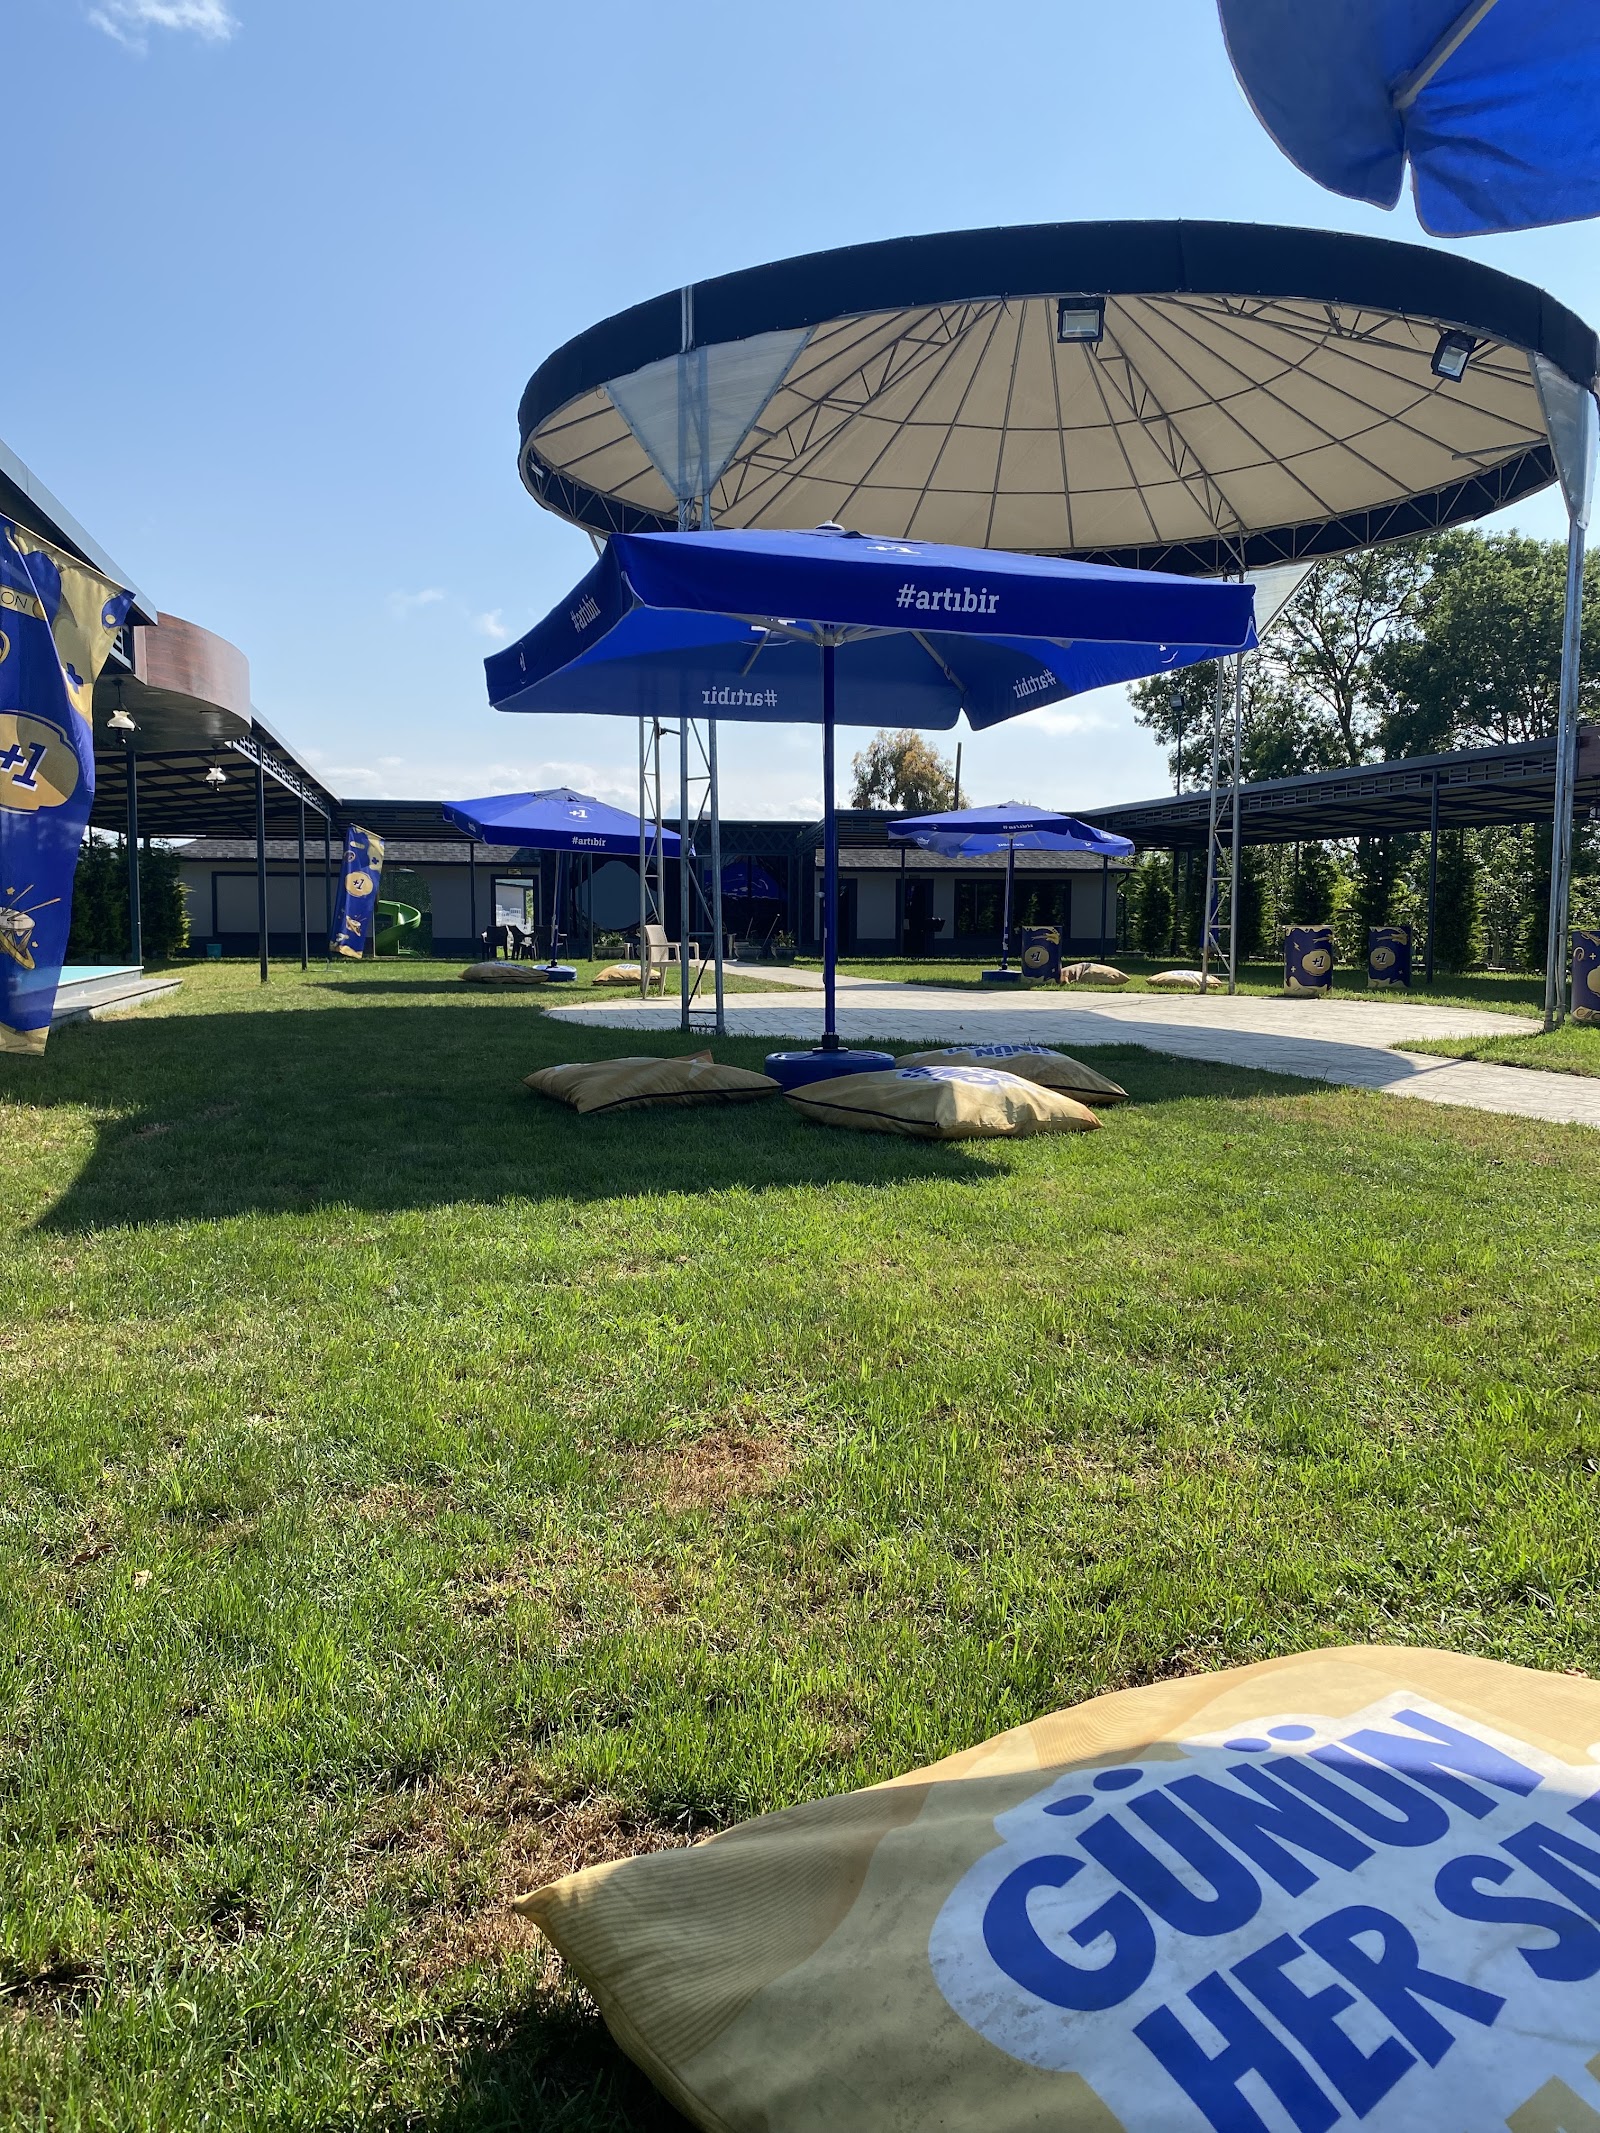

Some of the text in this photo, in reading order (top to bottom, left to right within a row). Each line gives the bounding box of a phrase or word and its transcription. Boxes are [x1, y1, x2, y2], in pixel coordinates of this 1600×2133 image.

[896, 583, 1000, 614] #artıbir
[0, 744, 47, 791] +1
[569, 809, 588, 819] +1
[1312, 955, 1325, 969] +1
[1376, 952, 1387, 965] +1
[982, 1708, 1544, 2011] GÜNÜN
[1133, 1905, 1507, 2133] HER
